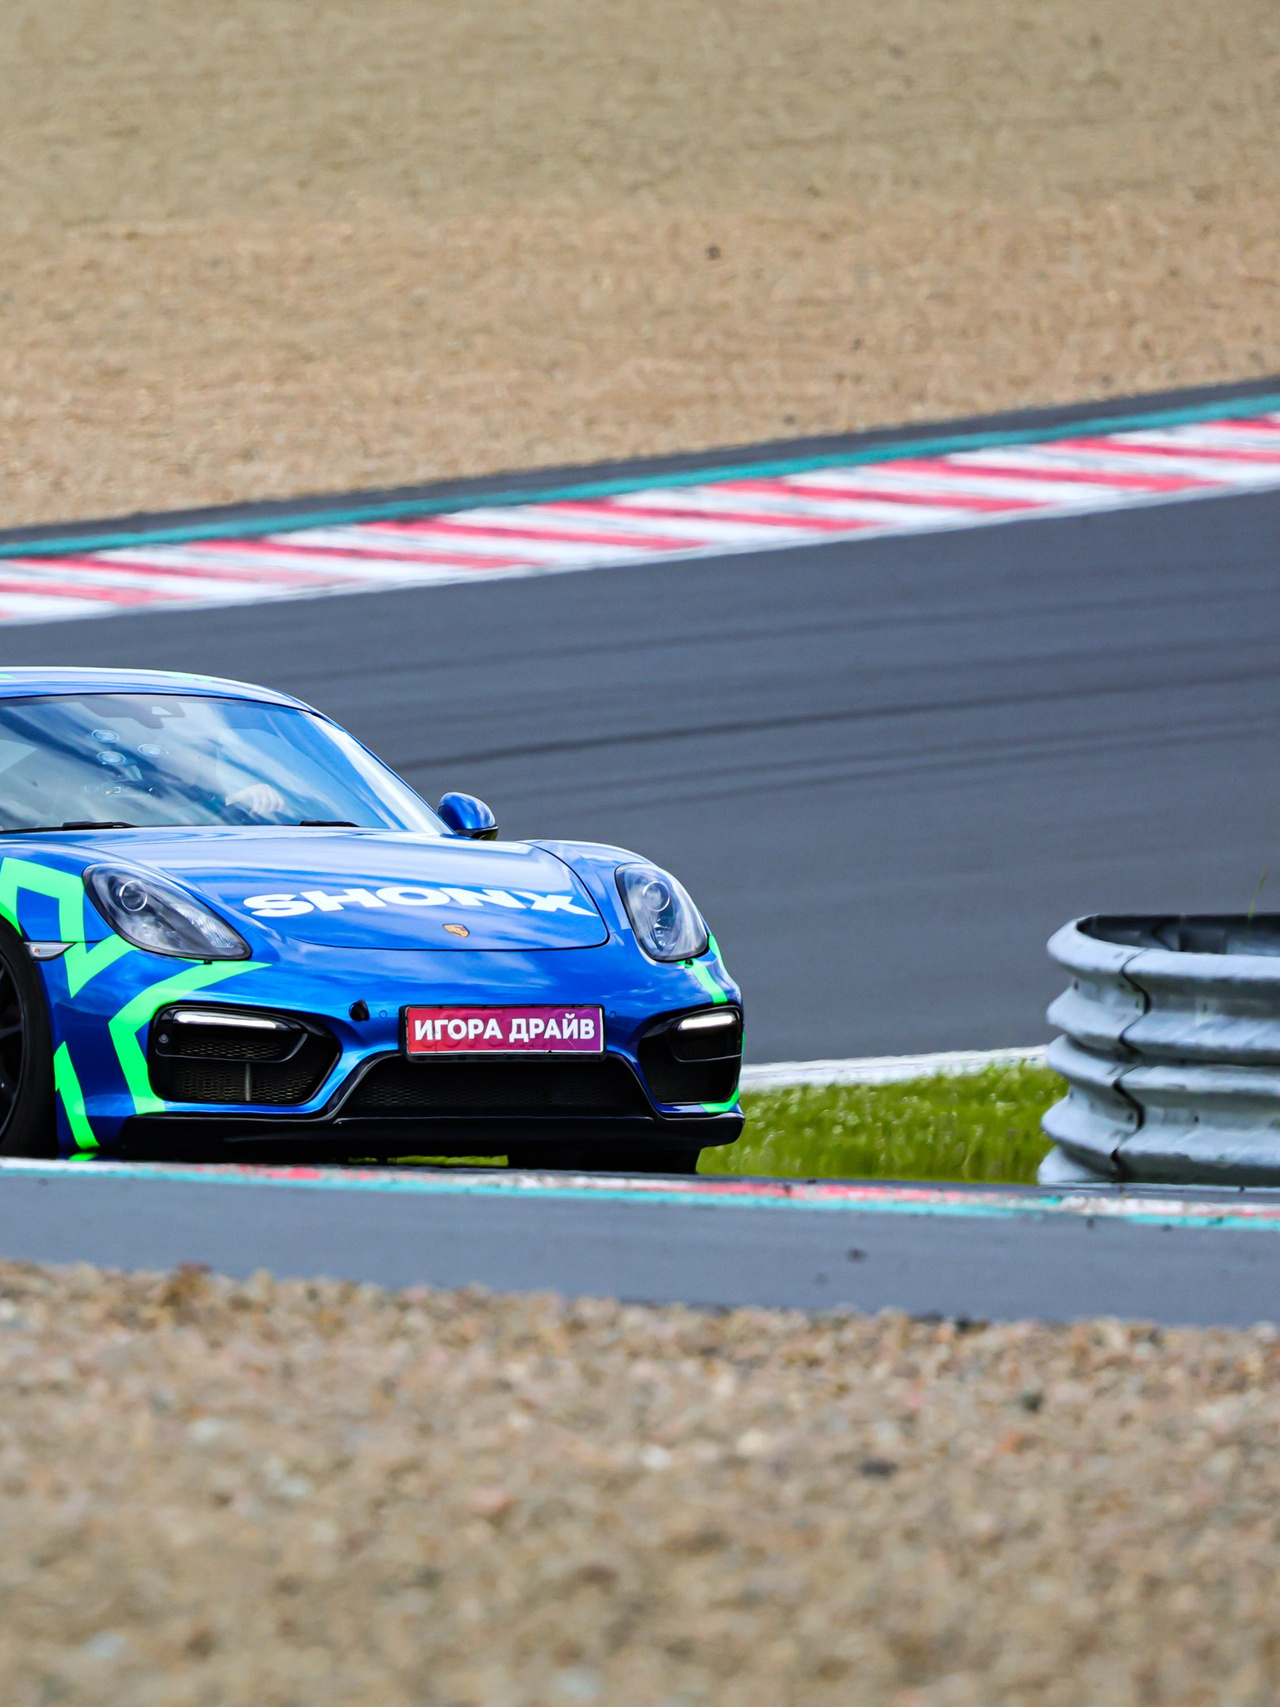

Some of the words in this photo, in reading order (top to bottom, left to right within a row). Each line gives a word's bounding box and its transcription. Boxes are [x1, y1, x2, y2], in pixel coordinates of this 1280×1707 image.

[243, 886, 600, 918] SHONX
[414, 1018, 503, 1041] ИГОРА
[509, 1013, 596, 1043] ДРАЙВ
